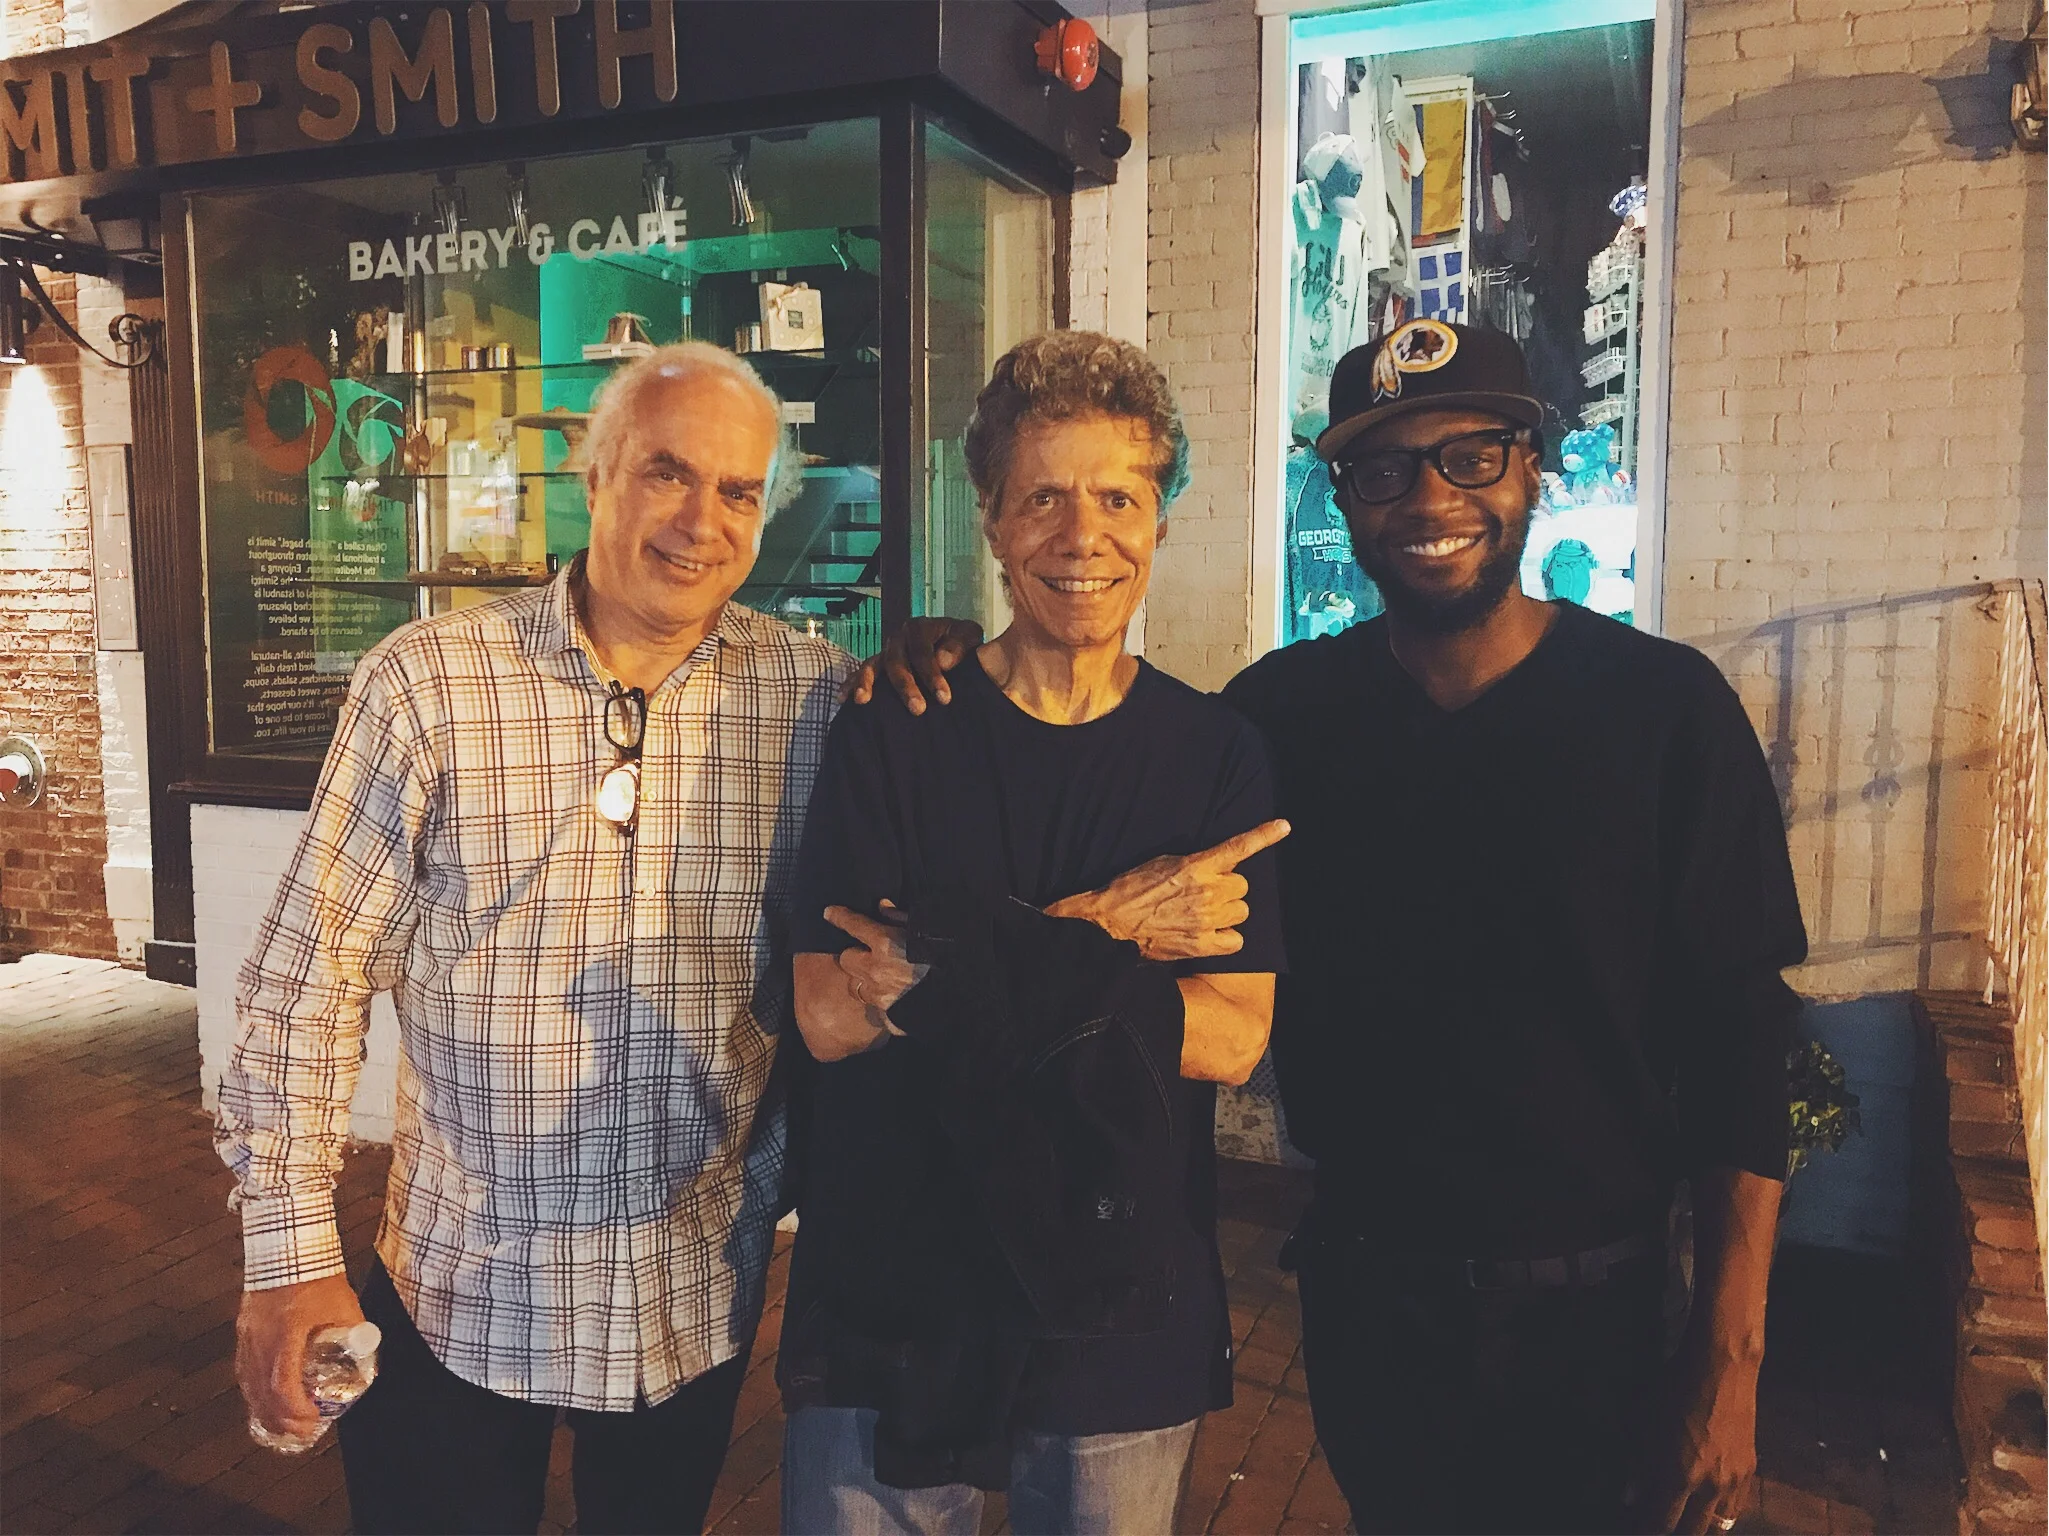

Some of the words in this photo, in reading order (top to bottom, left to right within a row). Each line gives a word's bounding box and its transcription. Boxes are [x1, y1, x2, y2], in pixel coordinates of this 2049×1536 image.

[297, 0, 678, 142] SMITH
[349, 225, 516, 282] BAKERY
[528, 222, 555, 266] &
[568, 196, 688, 261] CAFÉ
